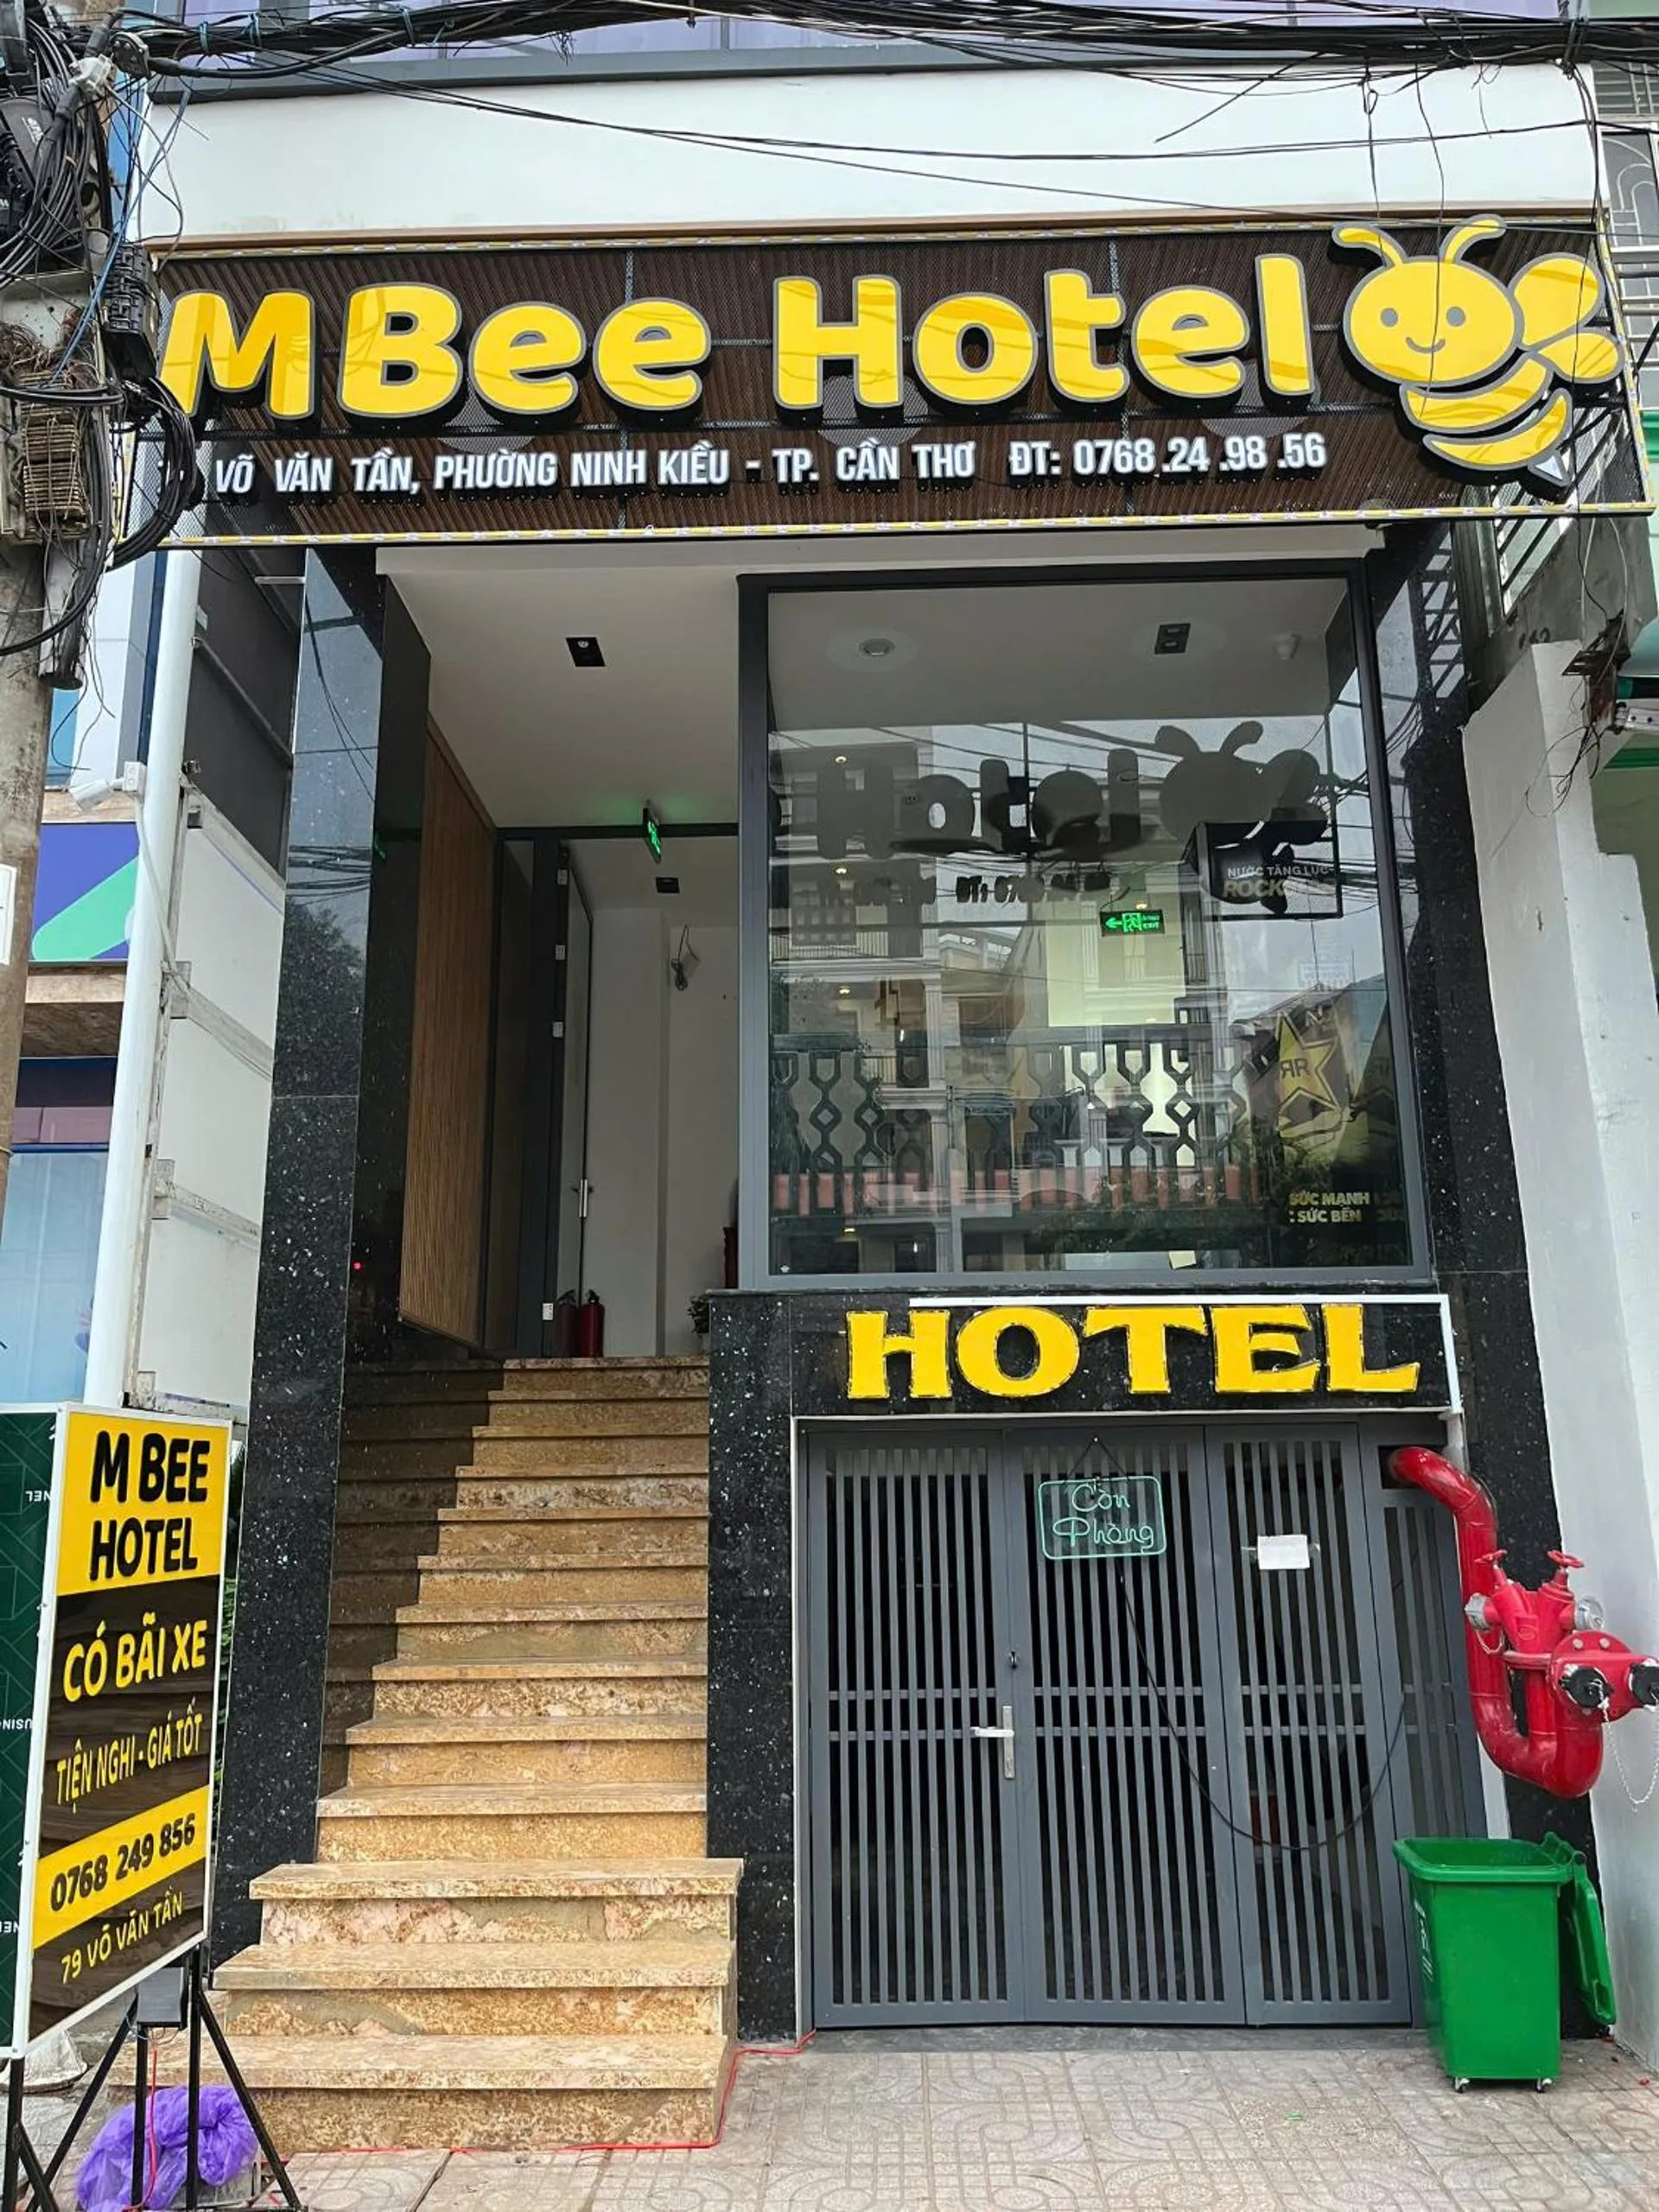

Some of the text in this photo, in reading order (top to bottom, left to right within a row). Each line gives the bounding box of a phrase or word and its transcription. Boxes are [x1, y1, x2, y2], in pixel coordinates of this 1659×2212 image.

[159, 253, 1314, 420] M Bee Hotel
[216, 453, 255, 493] VÕ
[274, 451, 334, 493] VĂN
[350, 447, 421, 495] TẦN,
[434, 448, 559, 490] PHƯỜNG
[570, 448, 646, 486] NINH
[658, 439, 729, 486] KIỀU
[772, 447, 820, 483] TP.
[836, 436, 899, 481] CẦN
[911, 440, 976, 479] THƠ
[1008, 440, 1061, 475] ĐT:
[1297, 1207, 1328, 1223] SỨC
[1322, 1192, 1370, 1207] MẠNH
[846, 1303, 1421, 1399] HOTEL
[90, 1430, 211, 1503] M BEE
[1072, 1484, 1130, 1512] Còn
[89, 1517, 198, 1581] HOTEL
[1052, 1516, 1154, 1552] Phòng
[64, 1611, 208, 1702] CÓ BÃI XE
[56, 1738, 93, 1814] TIỆN
[96, 1734, 136, 1789] NGHI
[147, 1710, 173, 1770] GIÁ
[175, 1695, 203, 1759] TỐT
[50, 1812, 195, 1912] 0768 249 856
[60, 1948, 82, 1985] 79
[153, 1884, 183, 1929] TẦN
